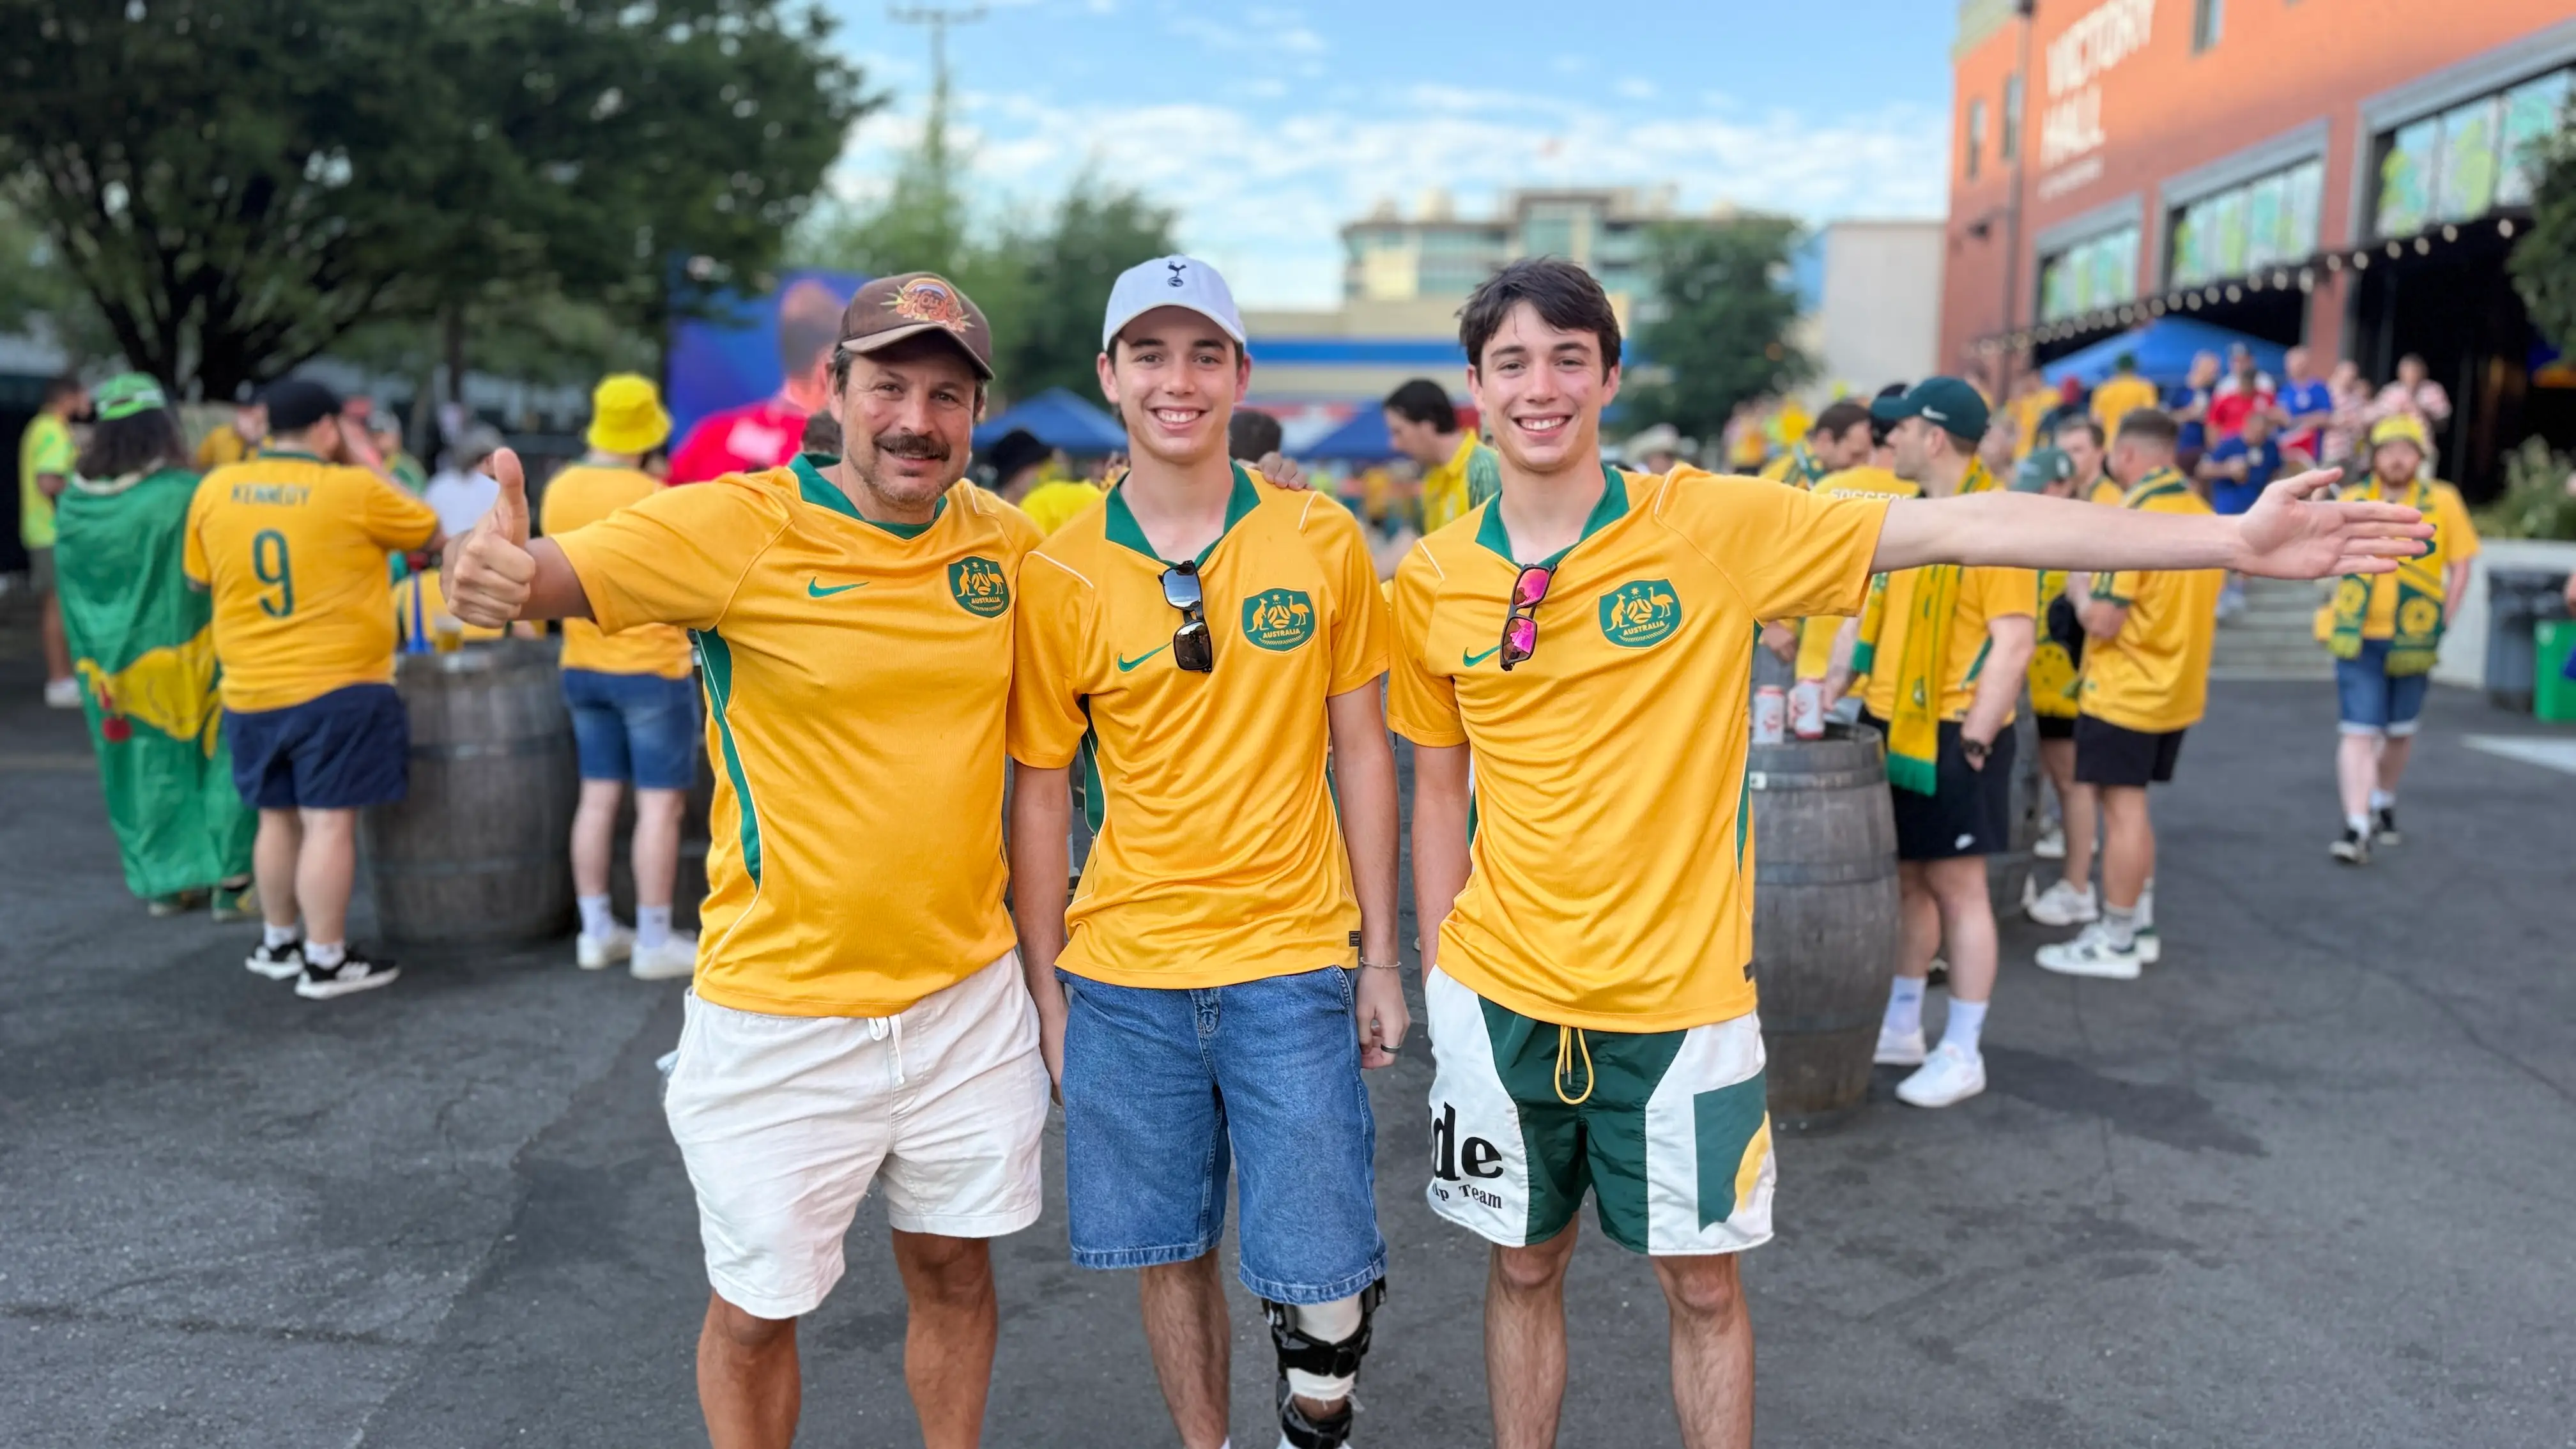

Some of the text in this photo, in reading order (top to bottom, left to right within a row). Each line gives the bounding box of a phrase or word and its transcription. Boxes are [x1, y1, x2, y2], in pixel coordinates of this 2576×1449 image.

[2046, 0, 2156, 98] VICTORY
[2040, 84, 2105, 170] HALL
[231, 484, 310, 505] KENNEDY
[253, 528, 294, 618] 9
[971, 596, 1001, 604] AUSTRALIA
[1262, 627, 1301, 639] AUSTRALIA
[1623, 620, 1666, 636] AUSTRALIA
[1429, 1101, 1504, 1181] de
[1459, 1184, 1503, 1209] Team
